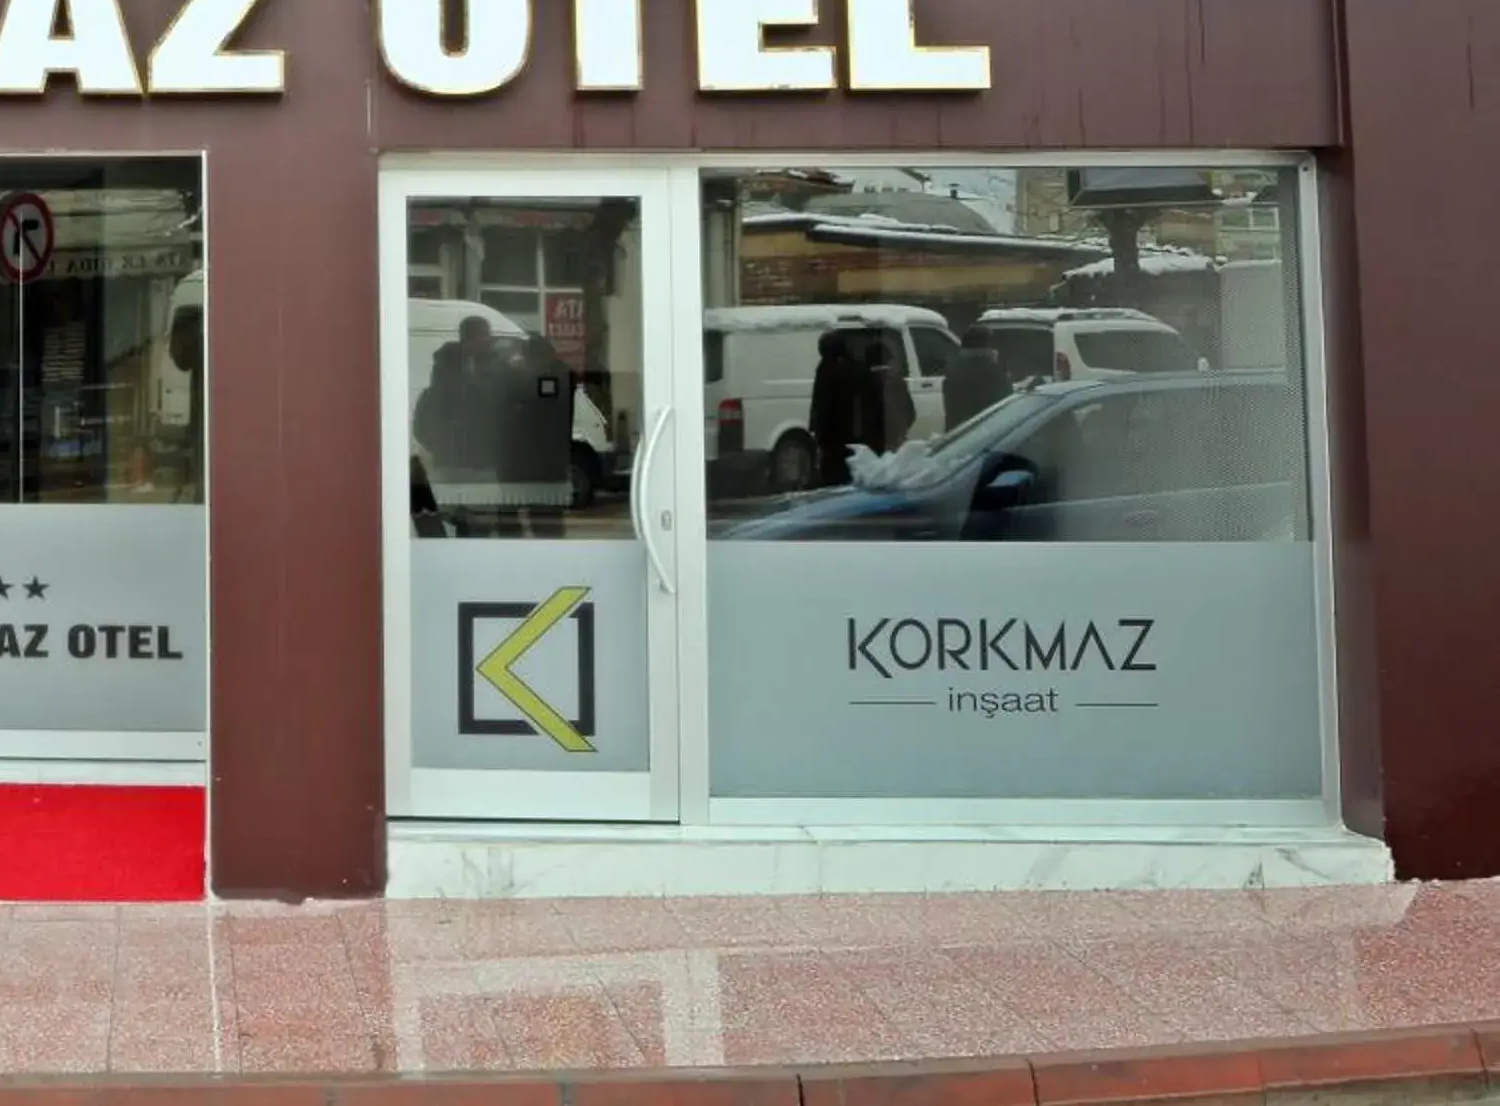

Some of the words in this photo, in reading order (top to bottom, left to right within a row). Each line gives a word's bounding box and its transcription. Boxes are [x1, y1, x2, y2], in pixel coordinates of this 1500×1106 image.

[67, 623, 184, 660] OTEL
[847, 617, 1158, 679] KORKMAZ
[948, 687, 1059, 719] inşaat
